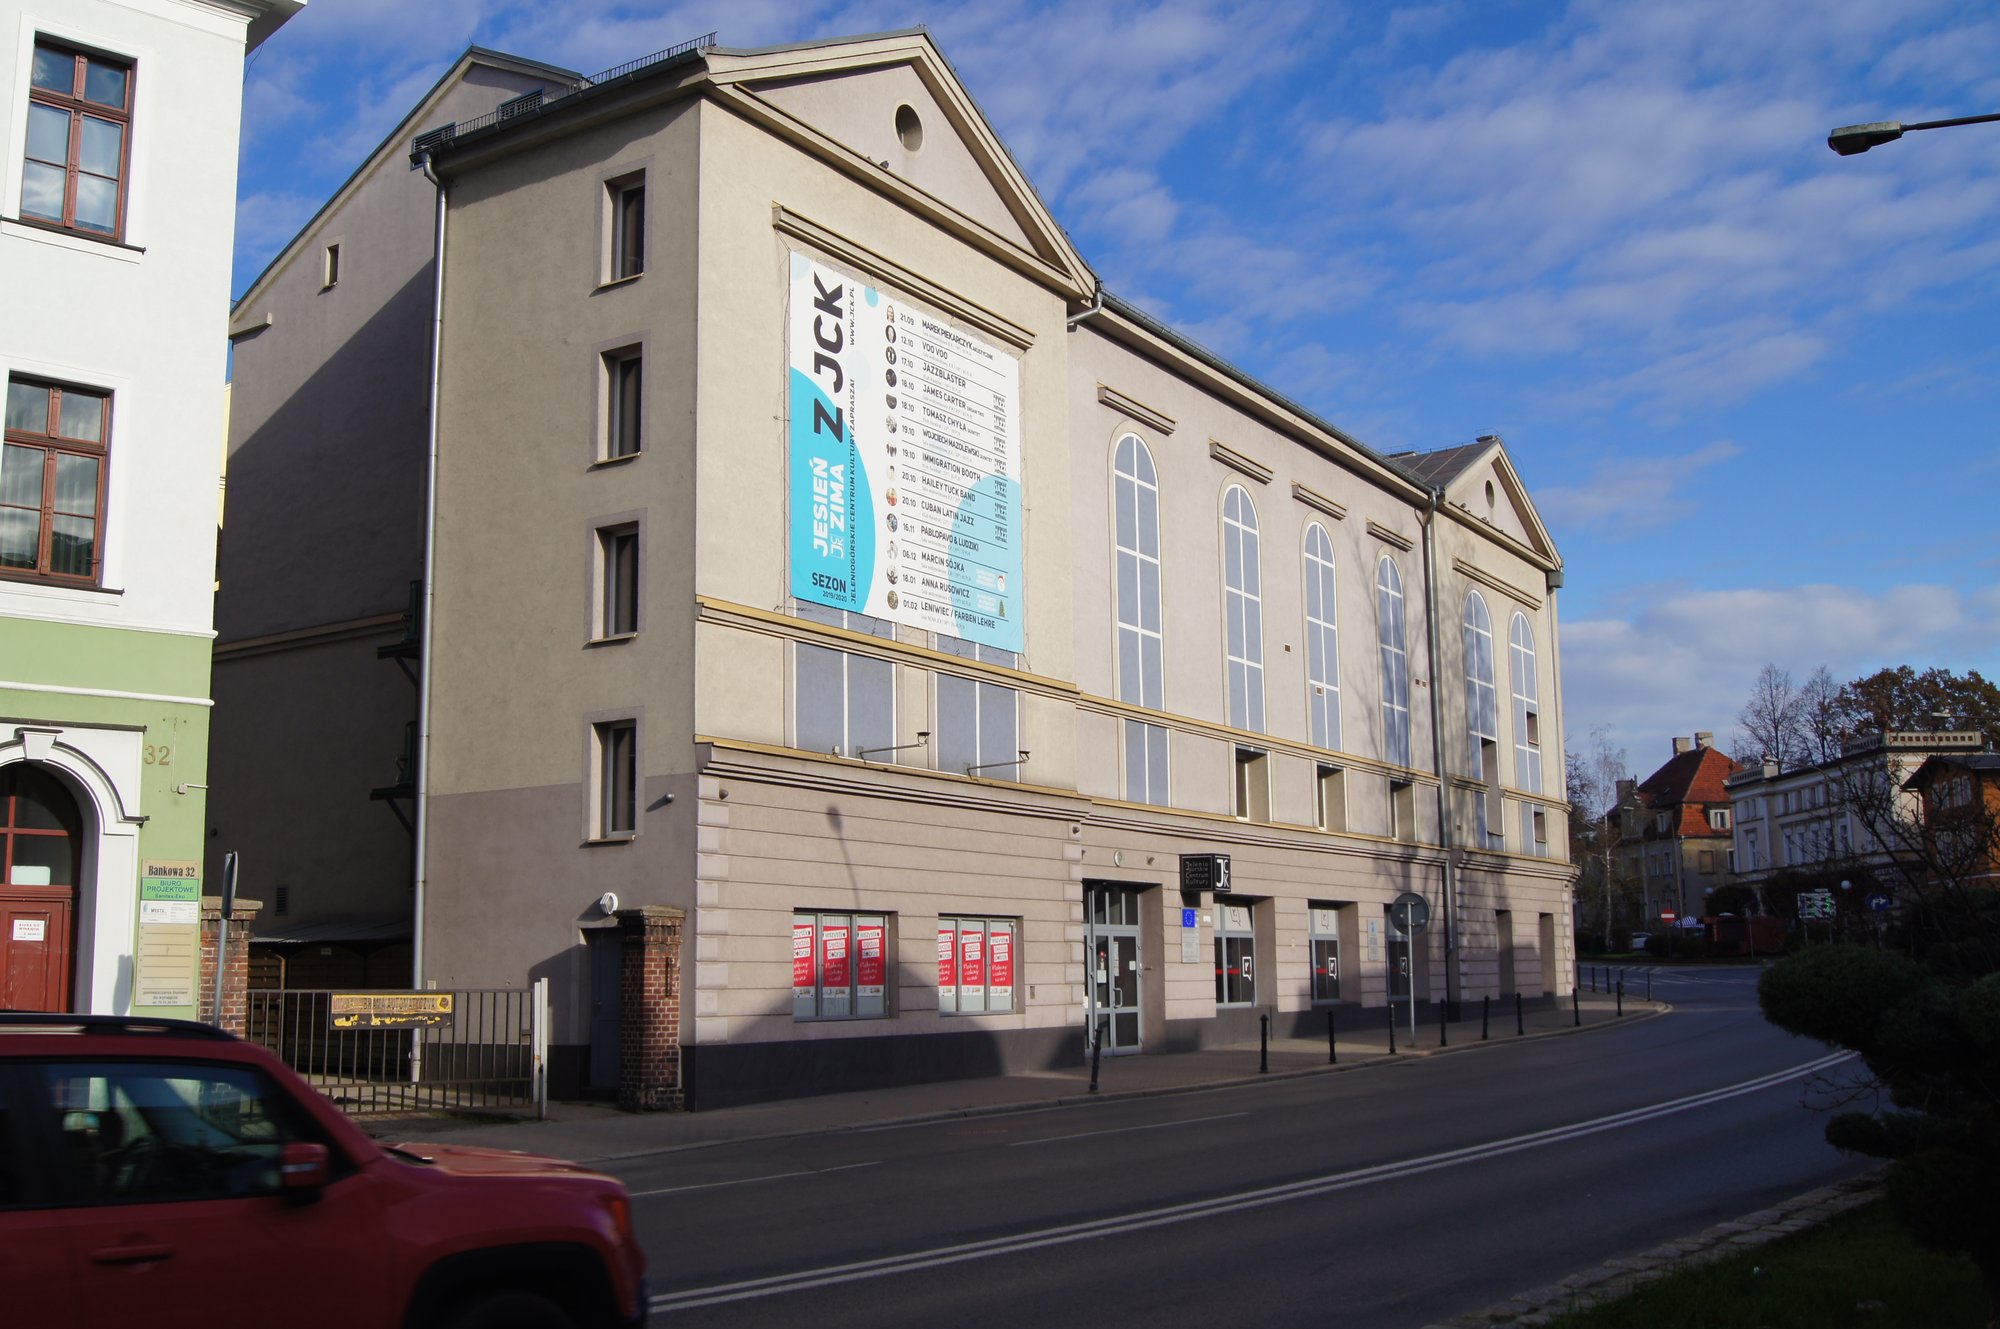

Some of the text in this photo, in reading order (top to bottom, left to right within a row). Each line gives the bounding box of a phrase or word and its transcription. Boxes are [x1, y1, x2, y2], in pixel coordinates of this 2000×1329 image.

[900, 313, 914, 326] 21.09
[922, 319, 941, 335] MAREK
[941, 328, 972, 349] PIEKARCZYK
[813, 270, 844, 444] Z JCK
[901, 336, 914, 348] 12.10
[922, 341, 935, 355] VOO
[935, 347, 948, 360] VOO
[901, 357, 914, 369] 17.10
[922, 362, 966, 388] JAZZBLASTER
[901, 379, 915, 391] 18.10
[923, 384, 943, 399] JAMES
[943, 393, 966, 409] CARTER
[901, 401, 915, 413] 18.10
[923, 406, 947, 424] TOMASZ
[947, 416, 967, 432] CHYŁA
[902, 424, 915, 437] 19.10
[923, 429, 948, 445] WOJCIECH
[948, 436, 980, 458] MAZOLEWSKI
[902, 448, 916, 460] 19.10
[922, 453, 961, 474] IMMIGRATION
[961, 467, 981, 482] BOOTH
[830, 464, 845, 532] ZIMA
[902, 471, 916, 483] 20.10
[922, 476, 944, 490] HAILEY
[944, 483, 959, 497] TUCK
[960, 489, 976, 502] BAND
[809, 456, 828, 558] JESIEŃ
[902, 496, 916, 508] 20.10
[921, 501, 941, 516] CUBAN
[942, 507, 959, 520] LATIN
[959, 514, 975, 526] JAZZ
[903, 523, 915, 533] 16.11
[921, 526, 953, 543] PABLOPAVO
[953, 537, 958, 545] &
[958, 537, 979, 552] LUDZIKI
[902, 549, 917, 561] 06.12
[921, 551, 945, 566] MARCIN
[945, 557, 965, 573] SÓJKA
[811, 572, 847, 594] SEZON
[822, 590, 848, 602] 2019/2020
[902, 574, 916, 584] 18.01
[921, 578, 939, 589] ANNA
[939, 582, 970, 598] RUSOWICZ
[903, 599, 918, 610] 01.02
[920, 602, 950, 617] LENIWIEC
[954, 610, 977, 624] FARBEN
[977, 616, 996, 629] LEHRE
[144, 745, 170, 766] 32
[148, 866, 195, 877] Bankowa 32
